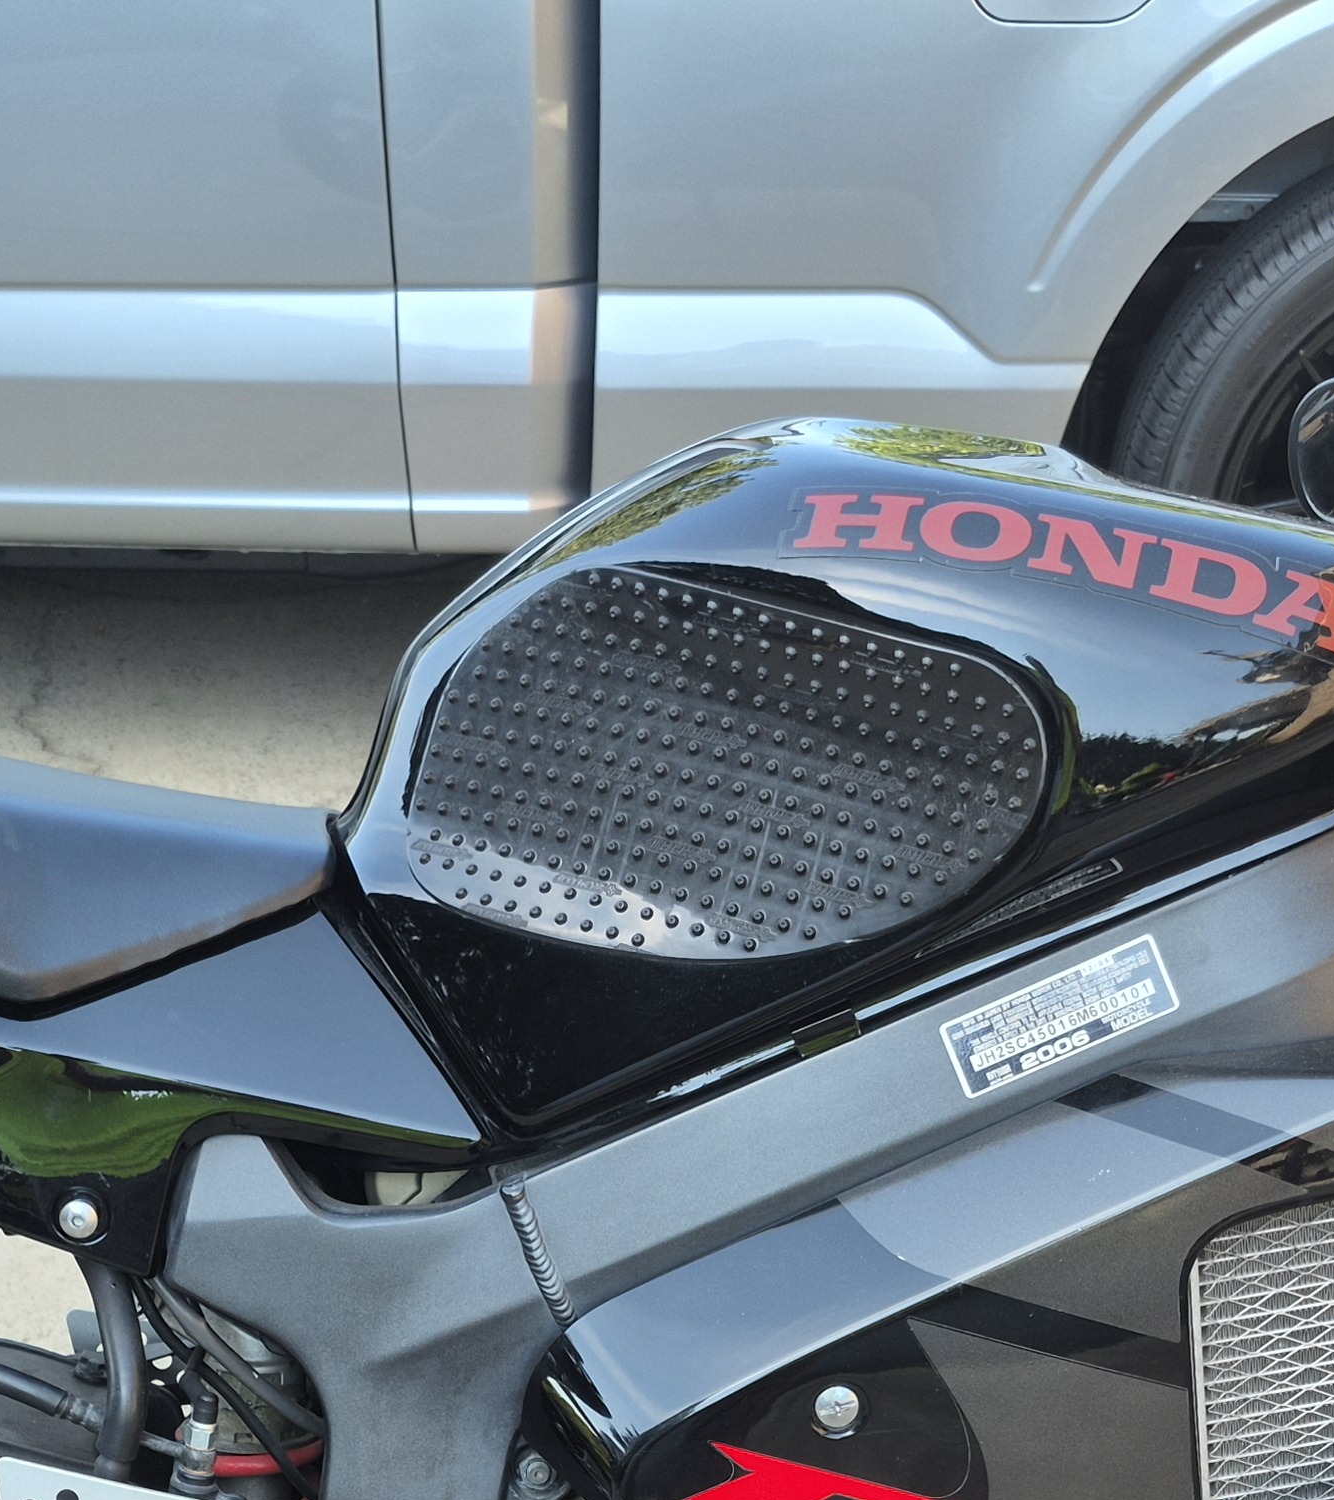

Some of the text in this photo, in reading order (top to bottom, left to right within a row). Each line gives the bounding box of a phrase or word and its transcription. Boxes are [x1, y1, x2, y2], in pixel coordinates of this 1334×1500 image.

[1101, 998, 1152, 1024] MOTORCYCLE
[1110, 1007, 1153, 1031] MODEL
[1018, 1029, 1091, 1071] 2006
